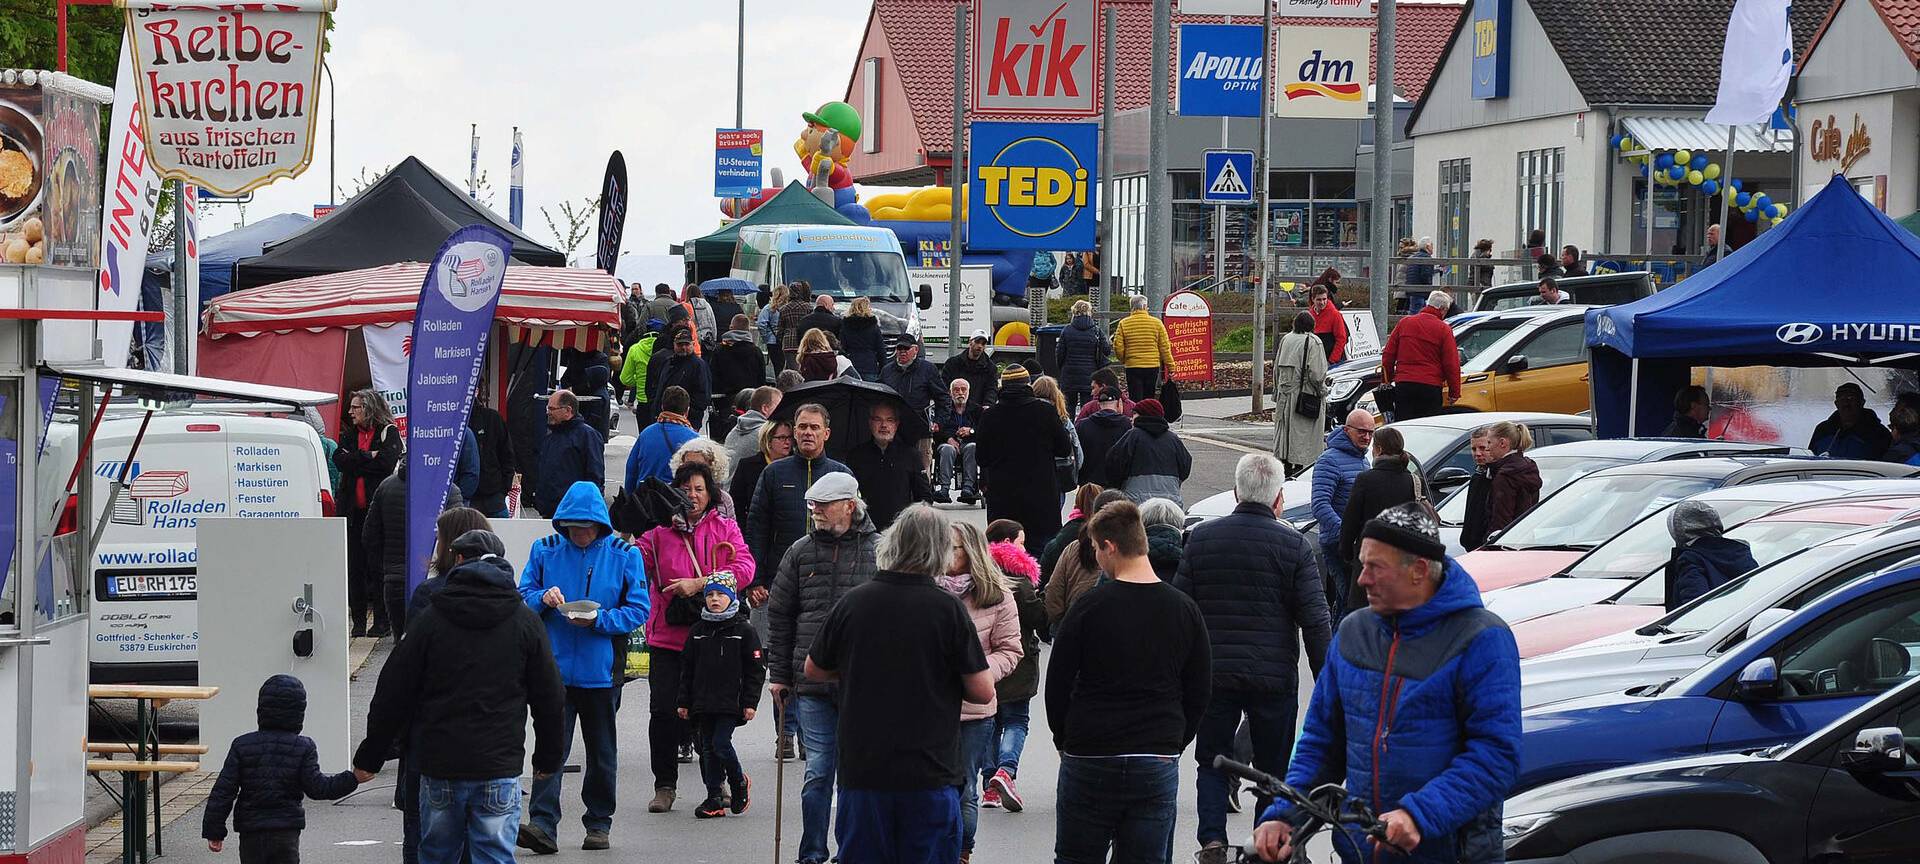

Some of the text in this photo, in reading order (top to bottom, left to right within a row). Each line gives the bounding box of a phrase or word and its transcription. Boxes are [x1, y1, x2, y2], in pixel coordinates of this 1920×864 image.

[144, 12, 303, 65] Reibe-
[1298, 50, 1354, 82] dm
[1223, 81, 1260, 91] OPTIK
[146, 64, 304, 122] kuchen
[159, 126, 296, 146] aus frischen
[176, 147, 277, 170] Kartoffeln
[718, 157, 759, 167] EU-Steuern
[718, 168, 760, 178] verhindern!
[978, 166, 1088, 207] TEDi
[1169, 302, 1188, 310] Cafe
[423, 320, 463, 332] Rolladen
[434, 346, 472, 359] Markisen
[417, 374, 459, 386] Jalousien
[427, 400, 461, 412] Fenster
[236, 447, 280, 456] Rolladen
[236, 463, 282, 472] Markisen
[237, 478, 289, 488] Haustüren
[238, 494, 276, 503] Fenster
[147, 500, 226, 515] Rolladen
[152, 516, 197, 529] Hans
[99, 549, 197, 565] www.rollad
[116, 577, 137, 592] EU
[146, 576, 166, 591] RH
[143, 633, 185, 641] Schenker
[192, 632, 199, 640] S
[120, 644, 197, 652] 53879 Euskirchen
